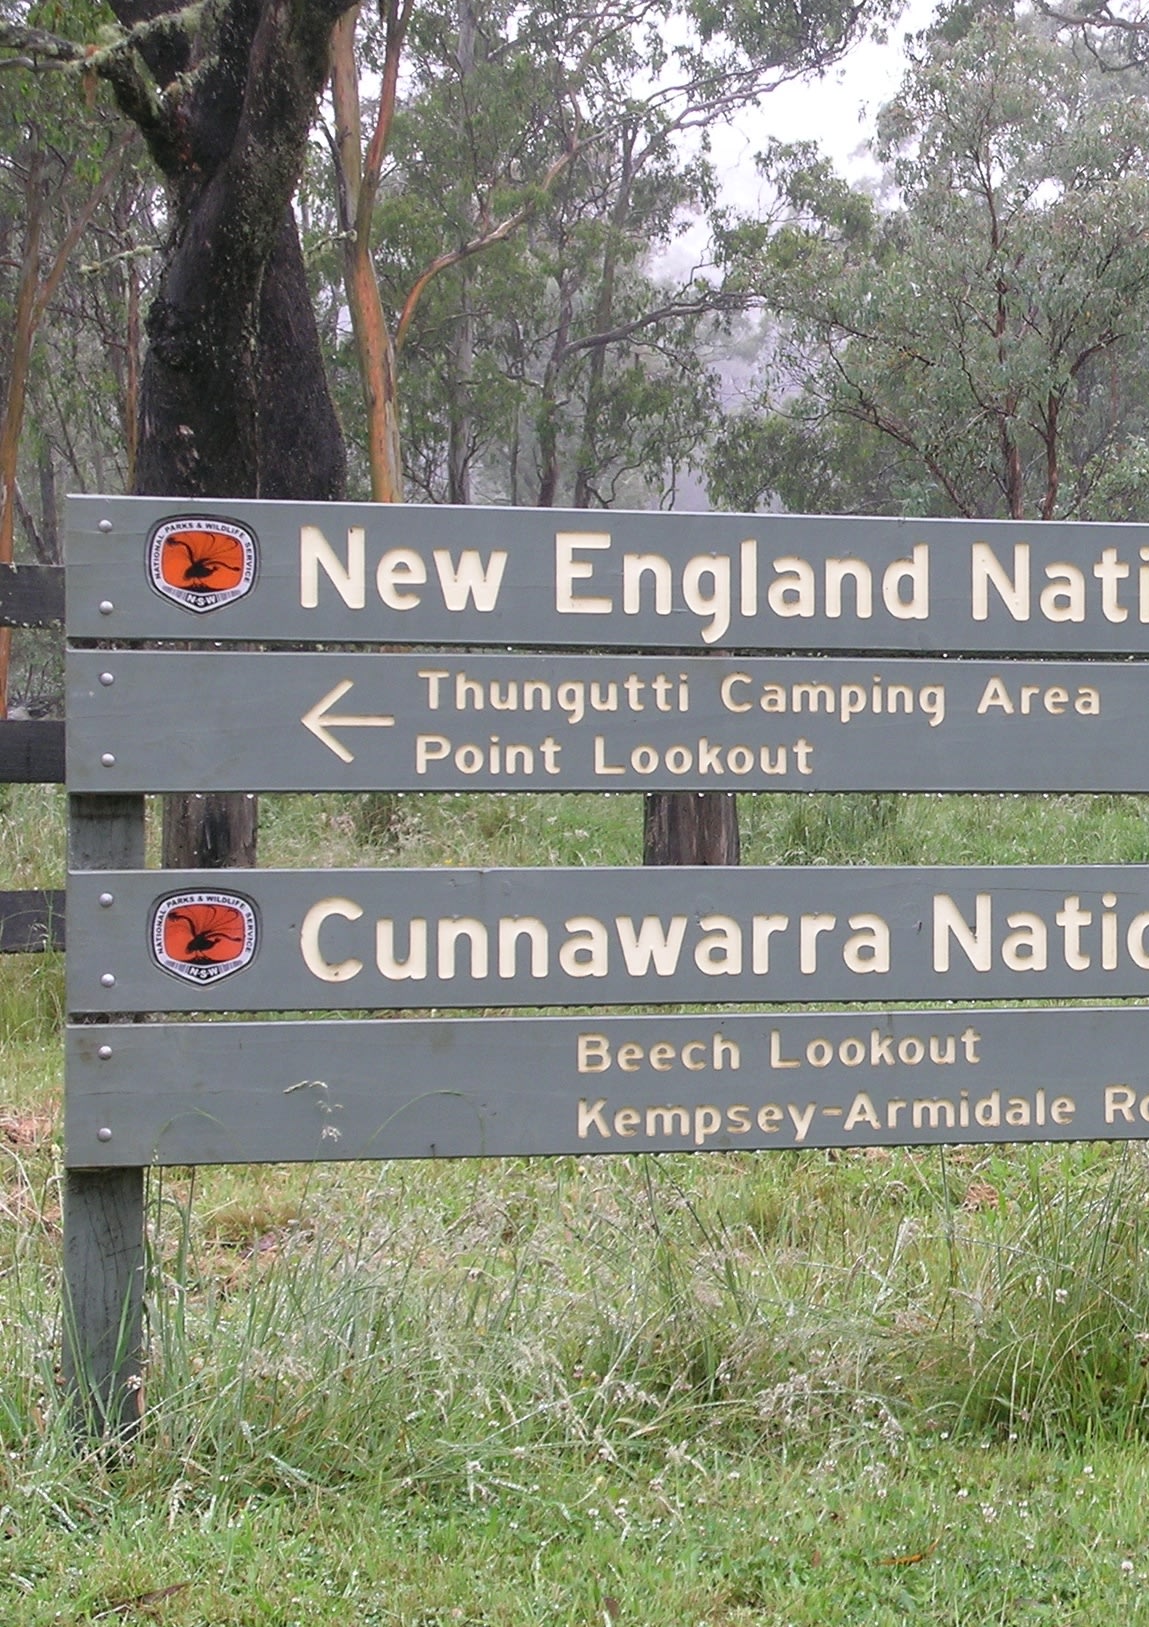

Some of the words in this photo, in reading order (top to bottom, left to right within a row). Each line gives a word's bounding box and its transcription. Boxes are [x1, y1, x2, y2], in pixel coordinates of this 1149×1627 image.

[153, 534, 164, 579] NATIONAL
[165, 522, 194, 533] PARKS
[205, 522, 245, 538] WILDLIFE
[245, 542, 253, 582] SERVICE
[301, 526, 508, 611] New
[555, 531, 930, 644] England
[417, 670, 689, 725] Thungutti
[721, 673, 945, 727] Camping
[976, 675, 1100, 715] Area
[415, 734, 561, 775] Point
[595, 736, 814, 776] Lookout
[156, 910, 166, 954] NATIONAL
[166, 895, 195, 908] PARKS
[206, 895, 246, 910] WILDLIFE
[245, 912, 253, 953] SERVICE
[300, 898, 891, 983] Cunnawarra
[577, 1031, 741, 1074] Beech
[770, 1025, 982, 1069] Lookout
[577, 1087, 1076, 1145] Kempsey-Armidale
